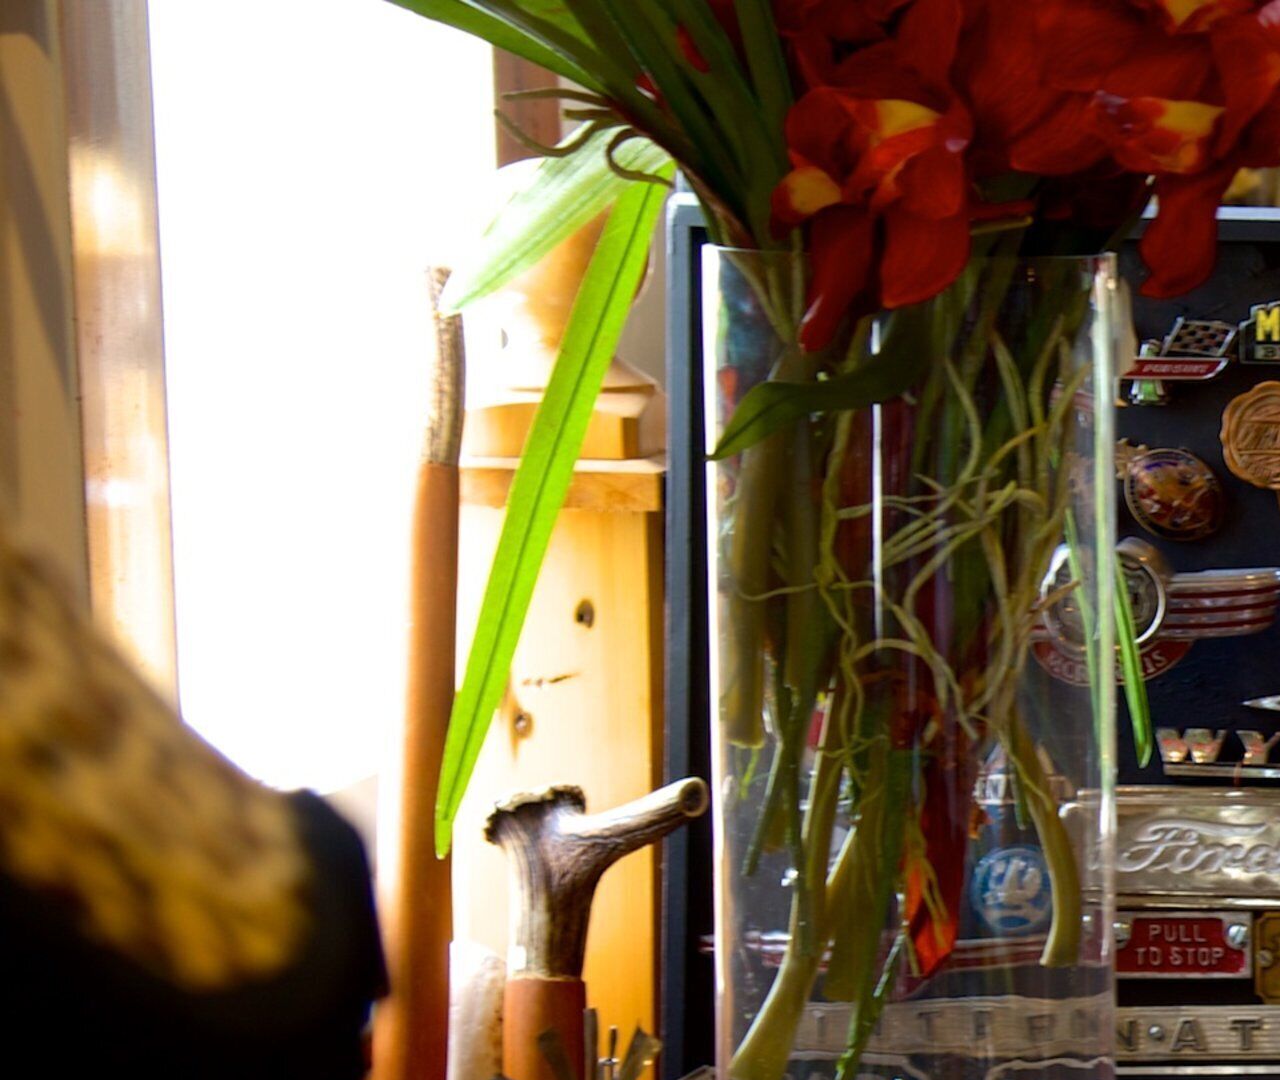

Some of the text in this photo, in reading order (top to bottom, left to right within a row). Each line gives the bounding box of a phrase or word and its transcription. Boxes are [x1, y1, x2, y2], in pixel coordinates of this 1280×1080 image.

[1149, 923, 1207, 943] PULL
[1135, 947, 1225, 967] TO STOP
